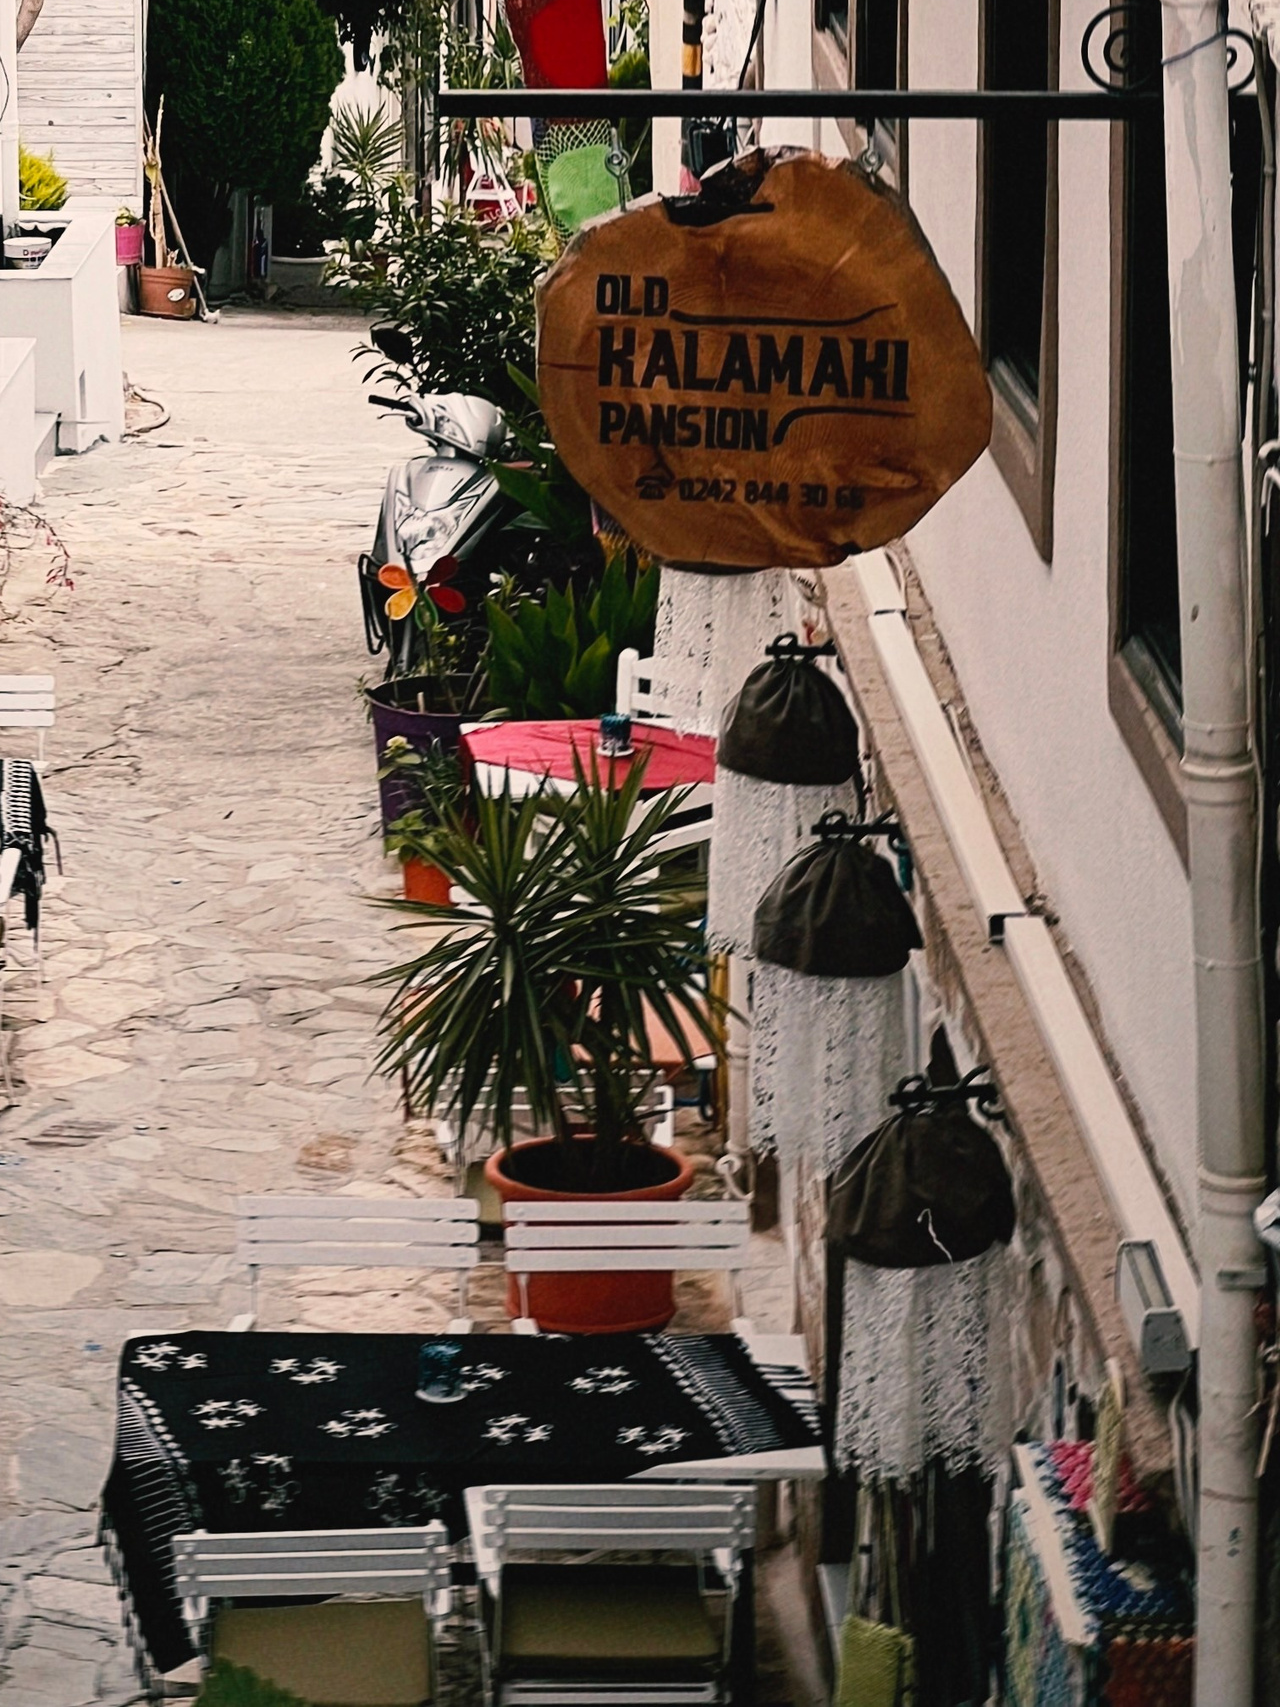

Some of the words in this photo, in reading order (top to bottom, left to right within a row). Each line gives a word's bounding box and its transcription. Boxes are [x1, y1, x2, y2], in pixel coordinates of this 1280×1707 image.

[595, 273, 669, 316] OLD
[596, 324, 910, 402] KALAMAKI
[598, 401, 769, 452] PANSION
[678, 477, 738, 503] 0242
[744, 479, 789, 506] 844
[798, 482, 828, 508] 30
